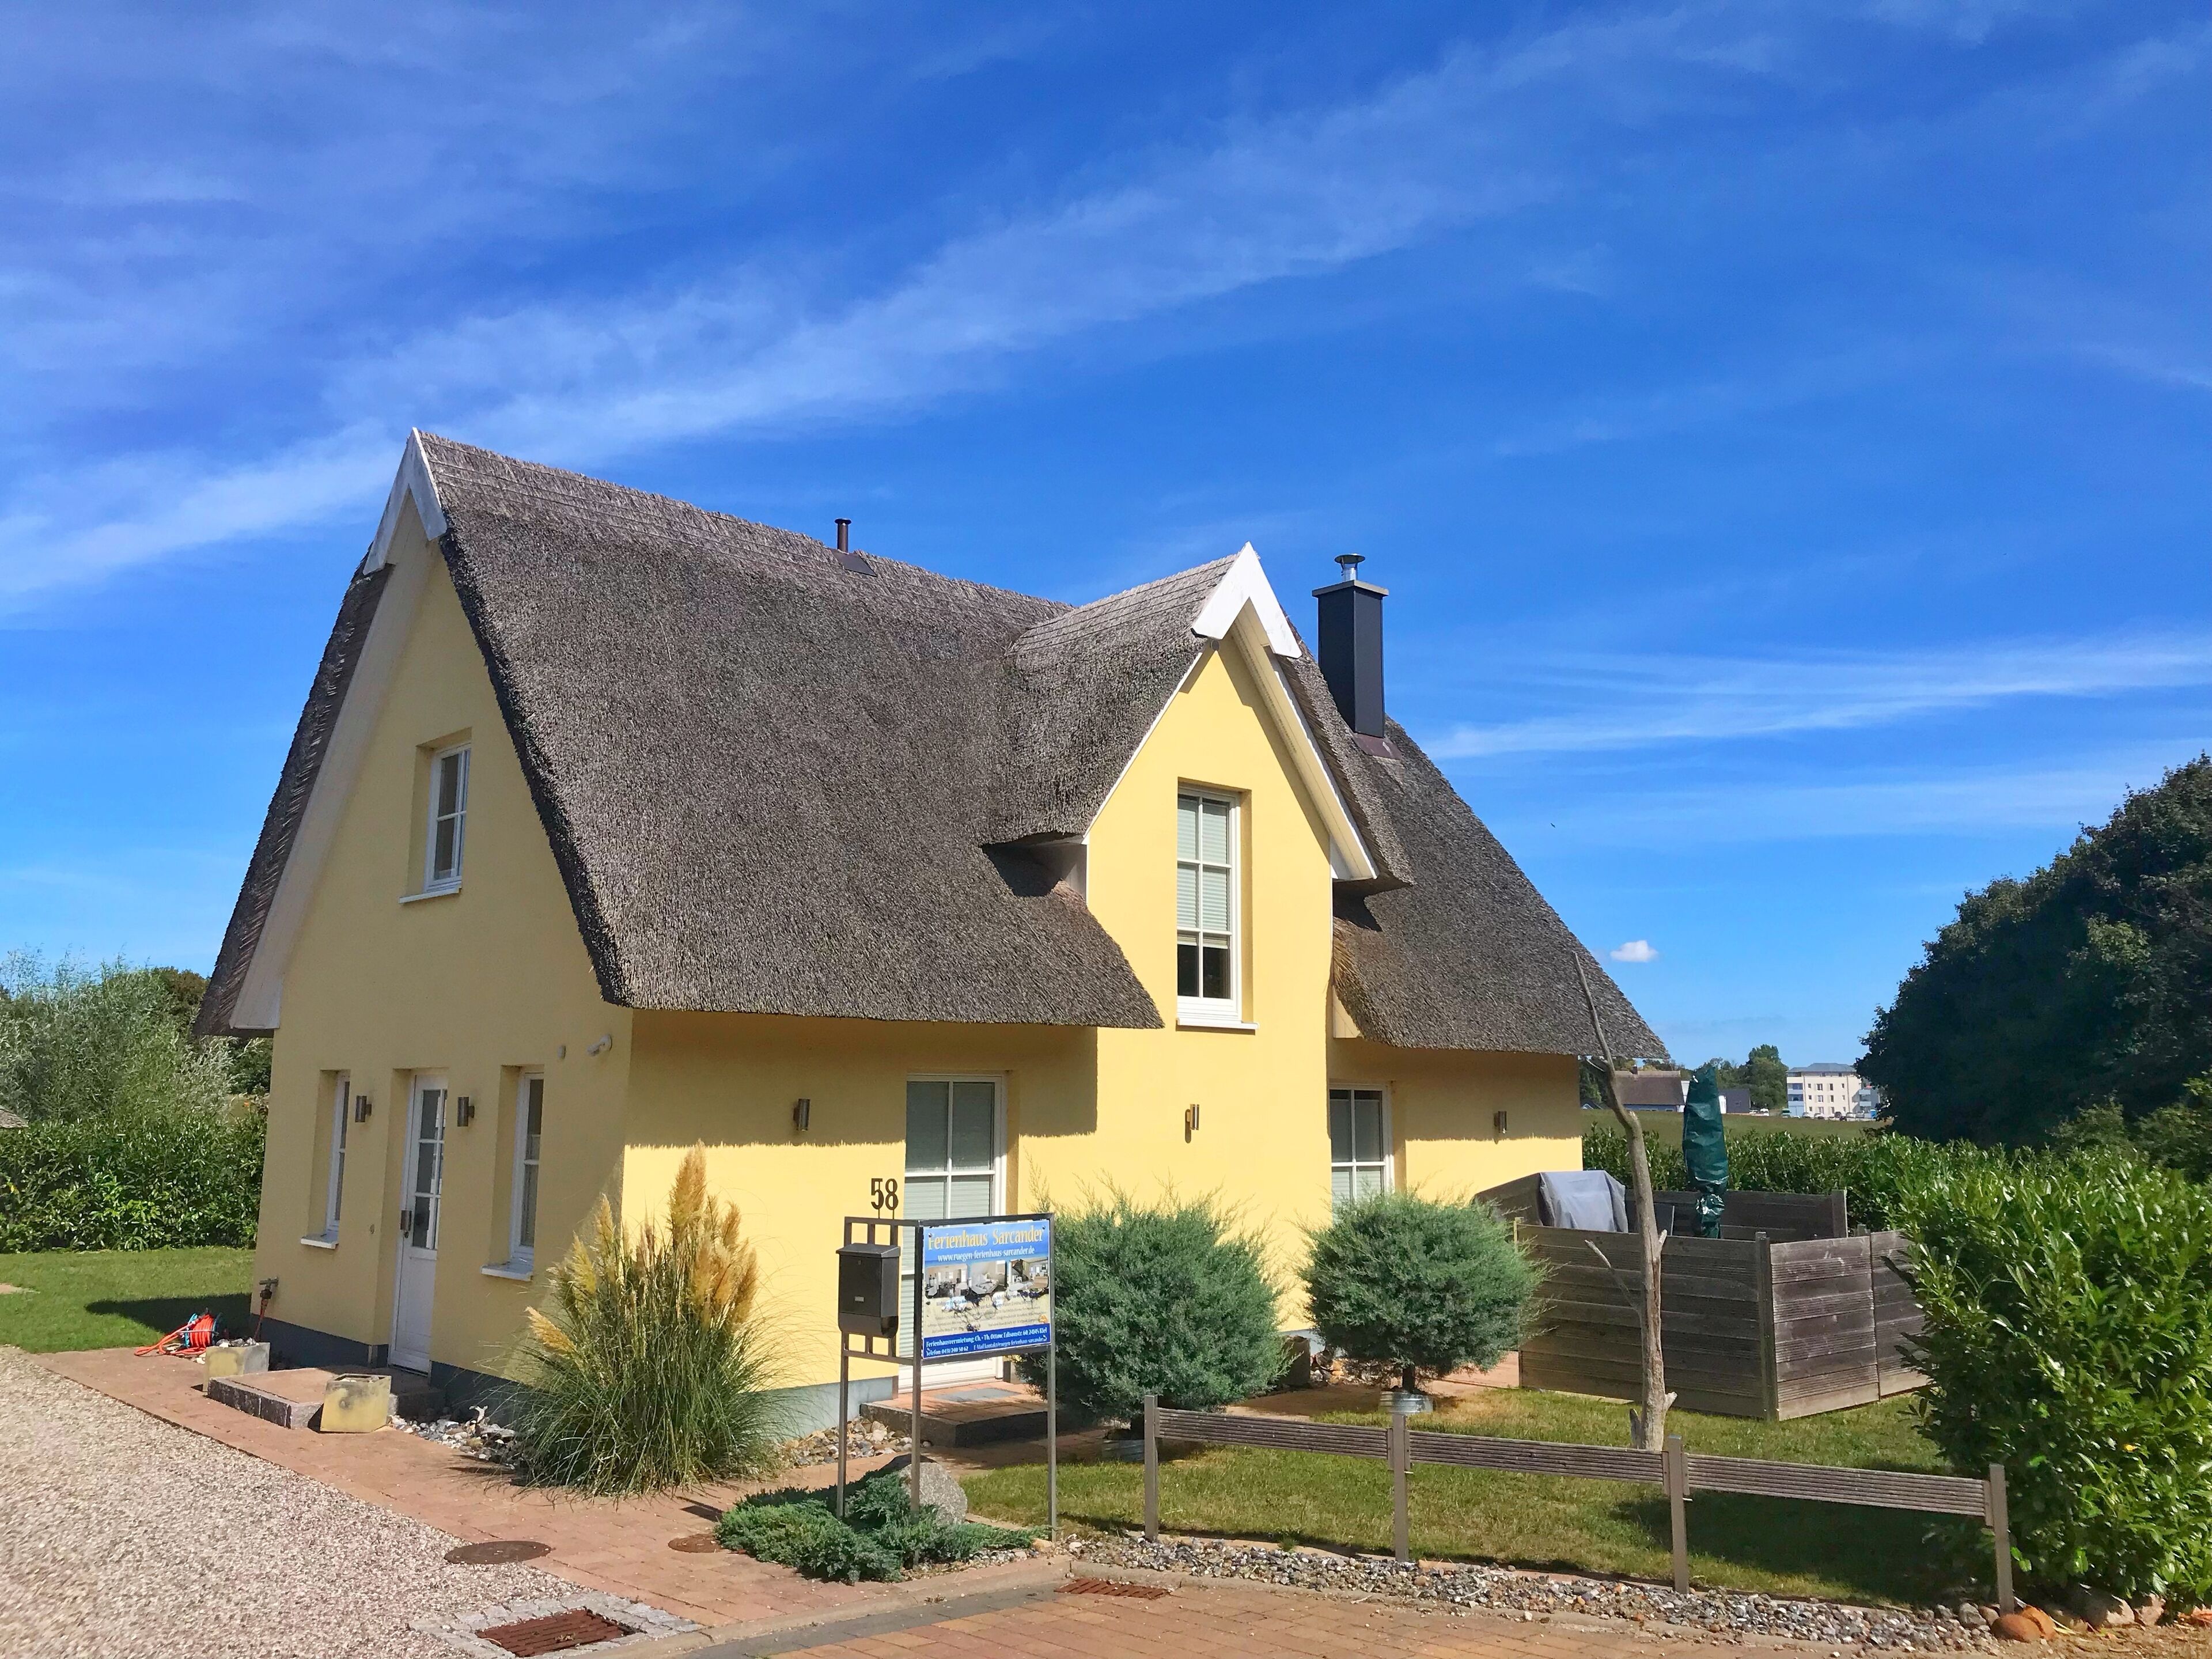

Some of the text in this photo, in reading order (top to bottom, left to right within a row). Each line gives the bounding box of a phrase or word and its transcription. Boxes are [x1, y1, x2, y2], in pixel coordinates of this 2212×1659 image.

[870, 1178, 899, 1210] 58
[928, 1225, 1043, 1251] Ferienhaus Sarcander
[938, 1245, 1035, 1263] www.ruegen-ferienhaus-sarcander.de
